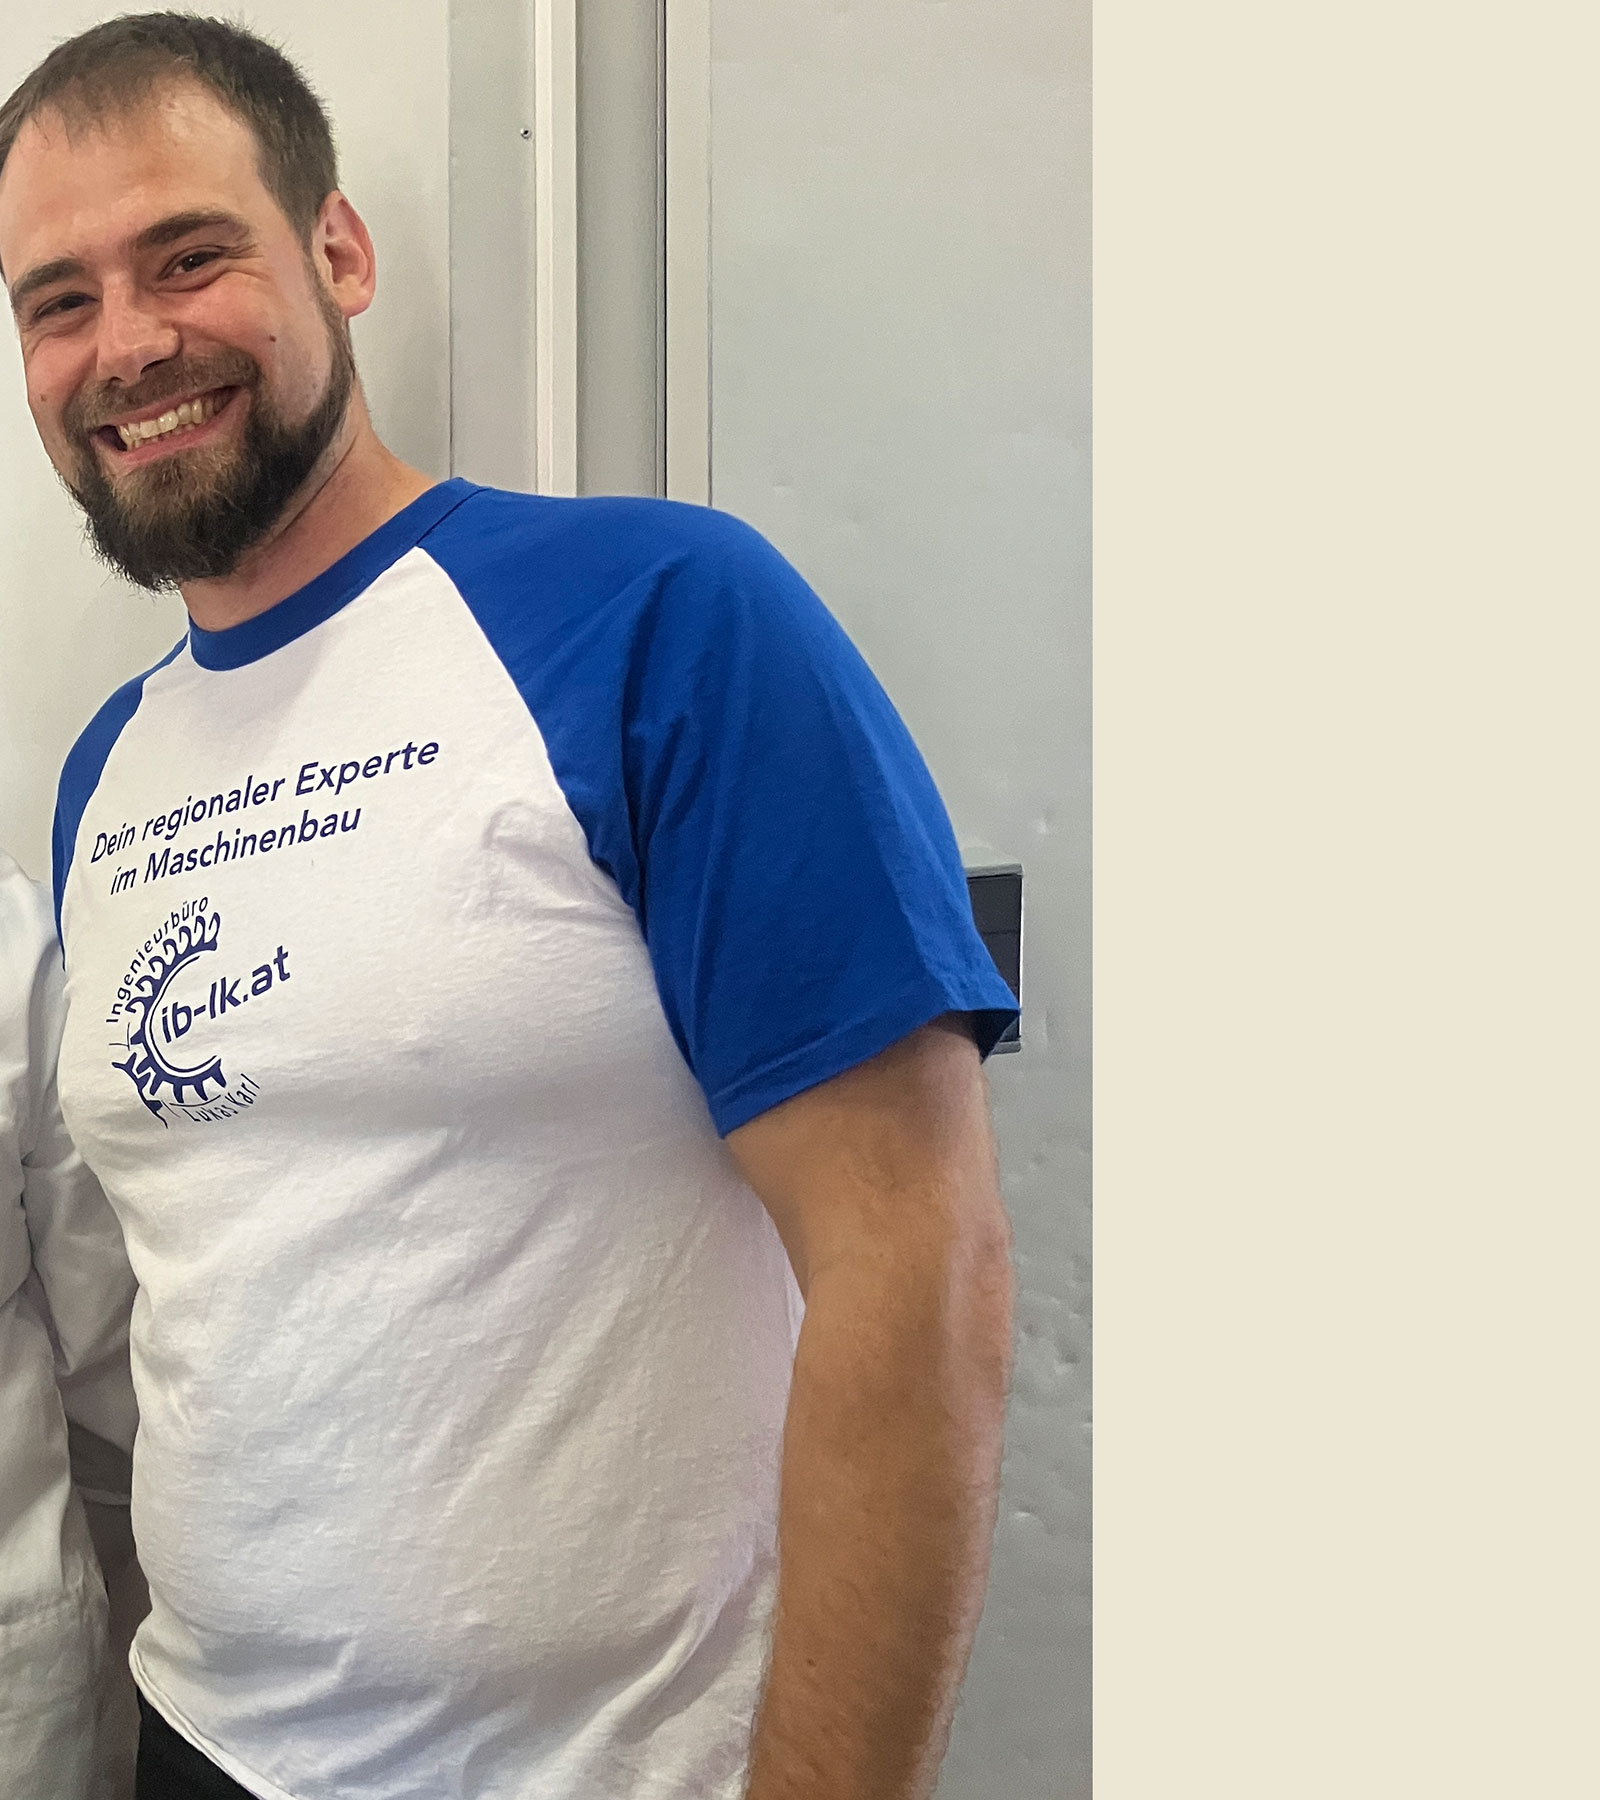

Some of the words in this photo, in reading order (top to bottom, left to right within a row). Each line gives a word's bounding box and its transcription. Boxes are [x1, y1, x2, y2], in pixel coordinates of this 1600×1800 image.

[90, 824, 136, 864] Dein
[141, 775, 286, 842] regionaler
[295, 740, 440, 796] Experte
[109, 865, 137, 896] im
[143, 808, 362, 884] Maschinenbau
[106, 896, 209, 1023] Ingenieurbüro
[161, 944, 291, 1044] ib-lk.at
[182, 1103, 238, 1123] Lukas
[224, 1073, 260, 1109] Karl
